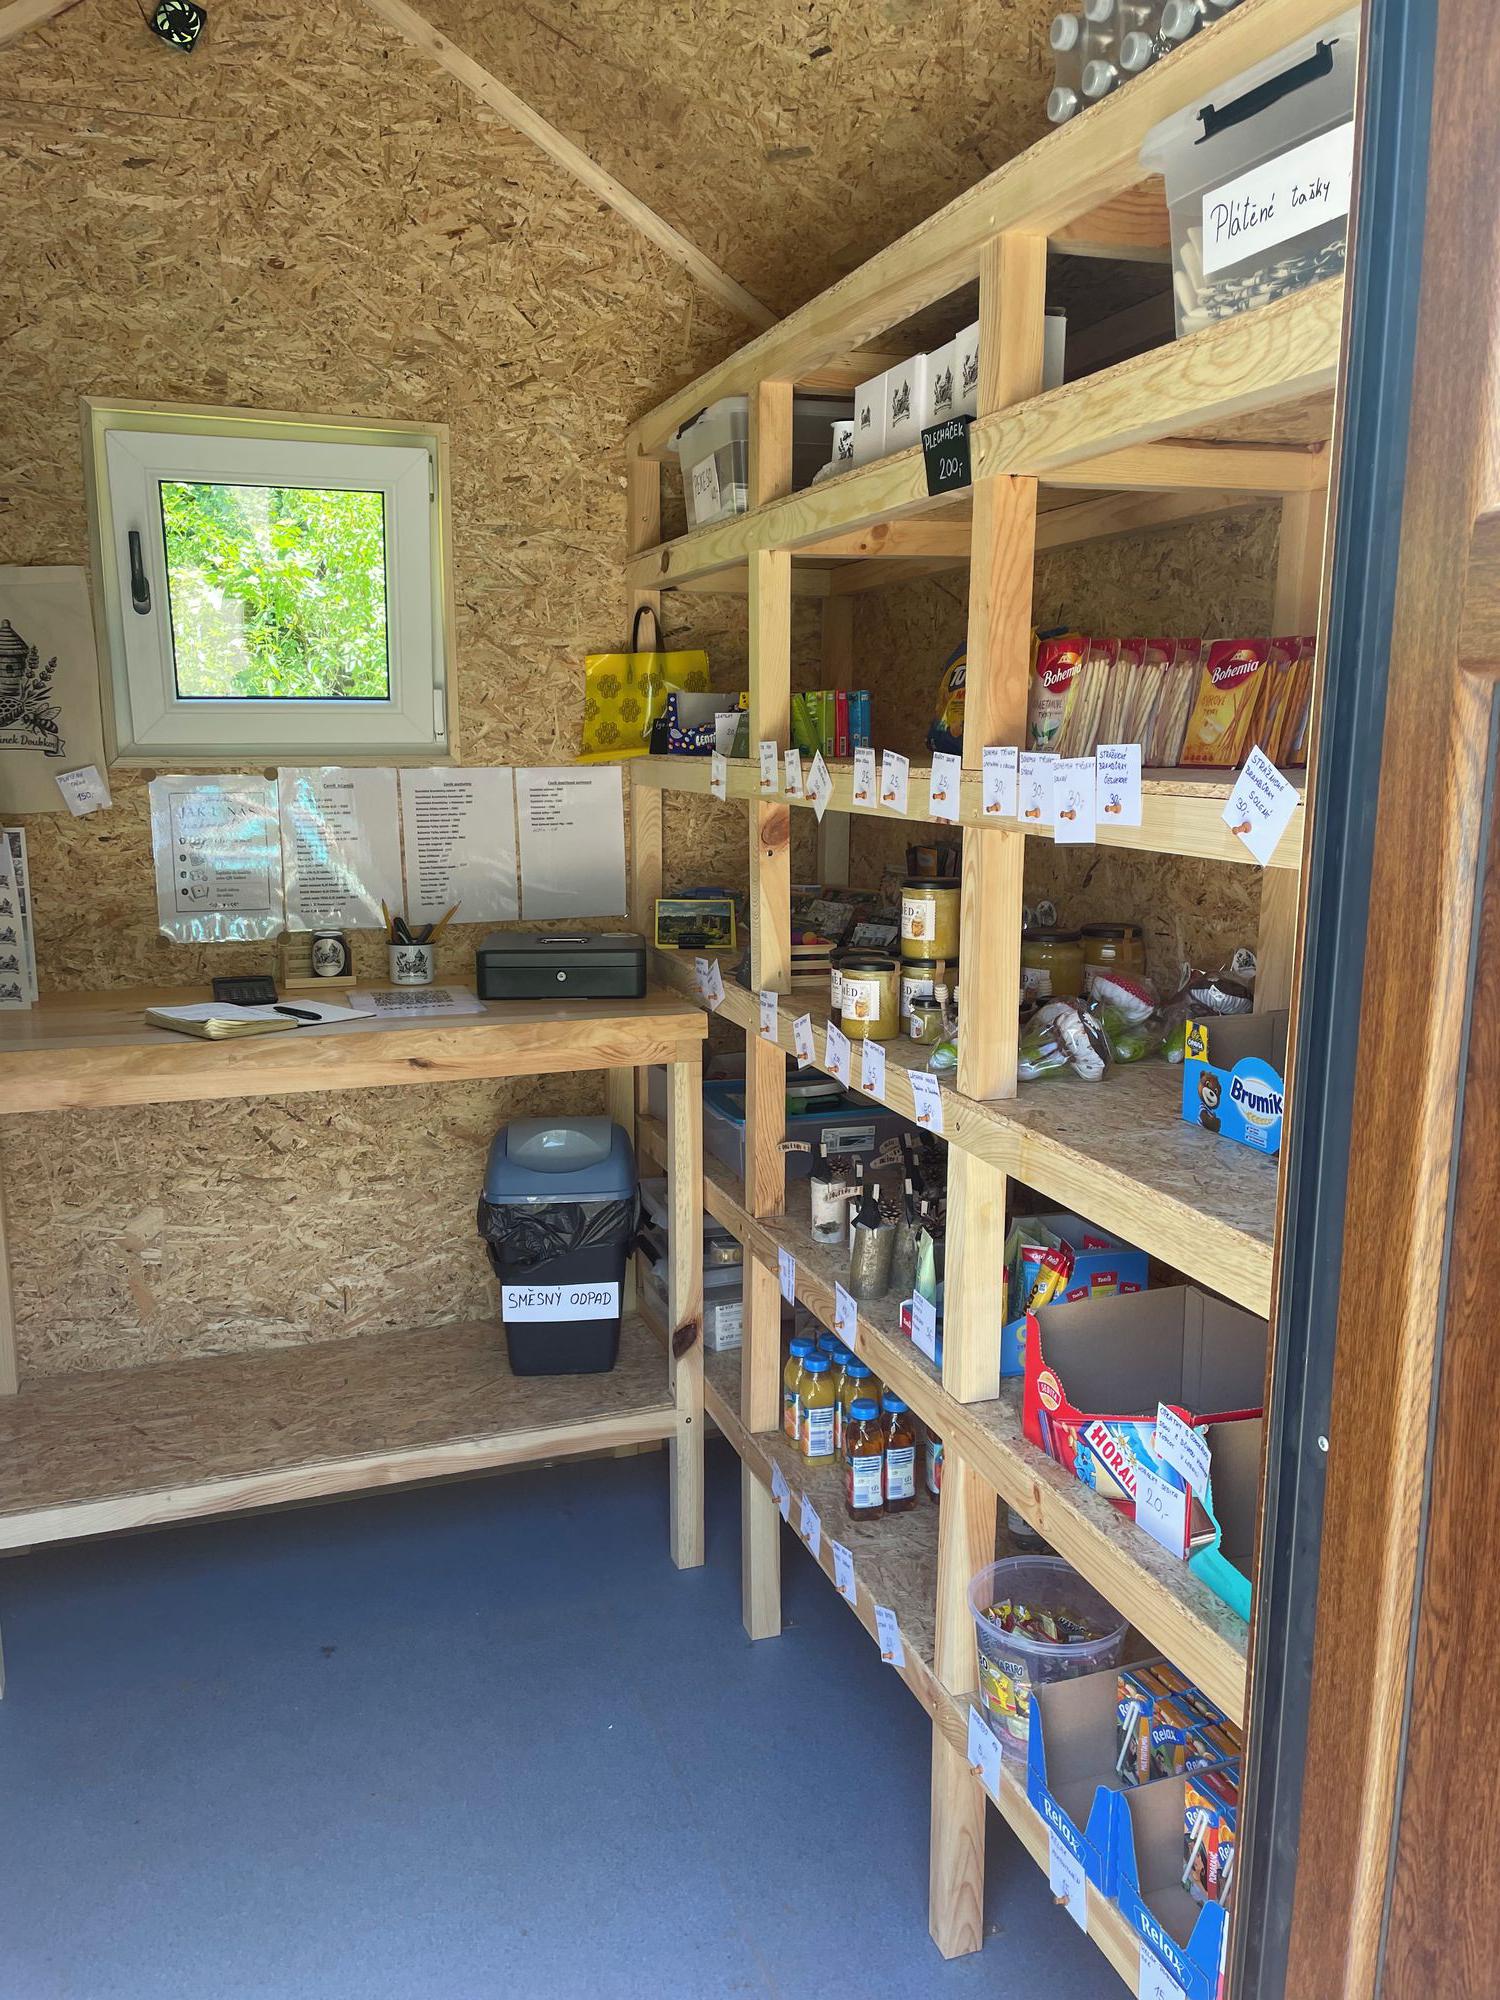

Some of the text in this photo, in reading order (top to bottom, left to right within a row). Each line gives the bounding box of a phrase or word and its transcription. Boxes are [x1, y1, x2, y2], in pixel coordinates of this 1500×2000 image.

[1291, 177, 1331, 208] tašky
[922, 421, 965, 451] PLECHÁČEK
[1042, 662, 1082, 688] Bohemia
[1211, 659, 1260, 684] Bohemia
[1230, 1077, 1284, 1115] Brumík
[508, 1287, 612, 1308] SMĚSNÝ ODPAD
[1152, 1729, 1180, 1744] Relax
[1044, 1798, 1081, 1852] Relax
[1141, 1912, 1183, 1978] Relax
